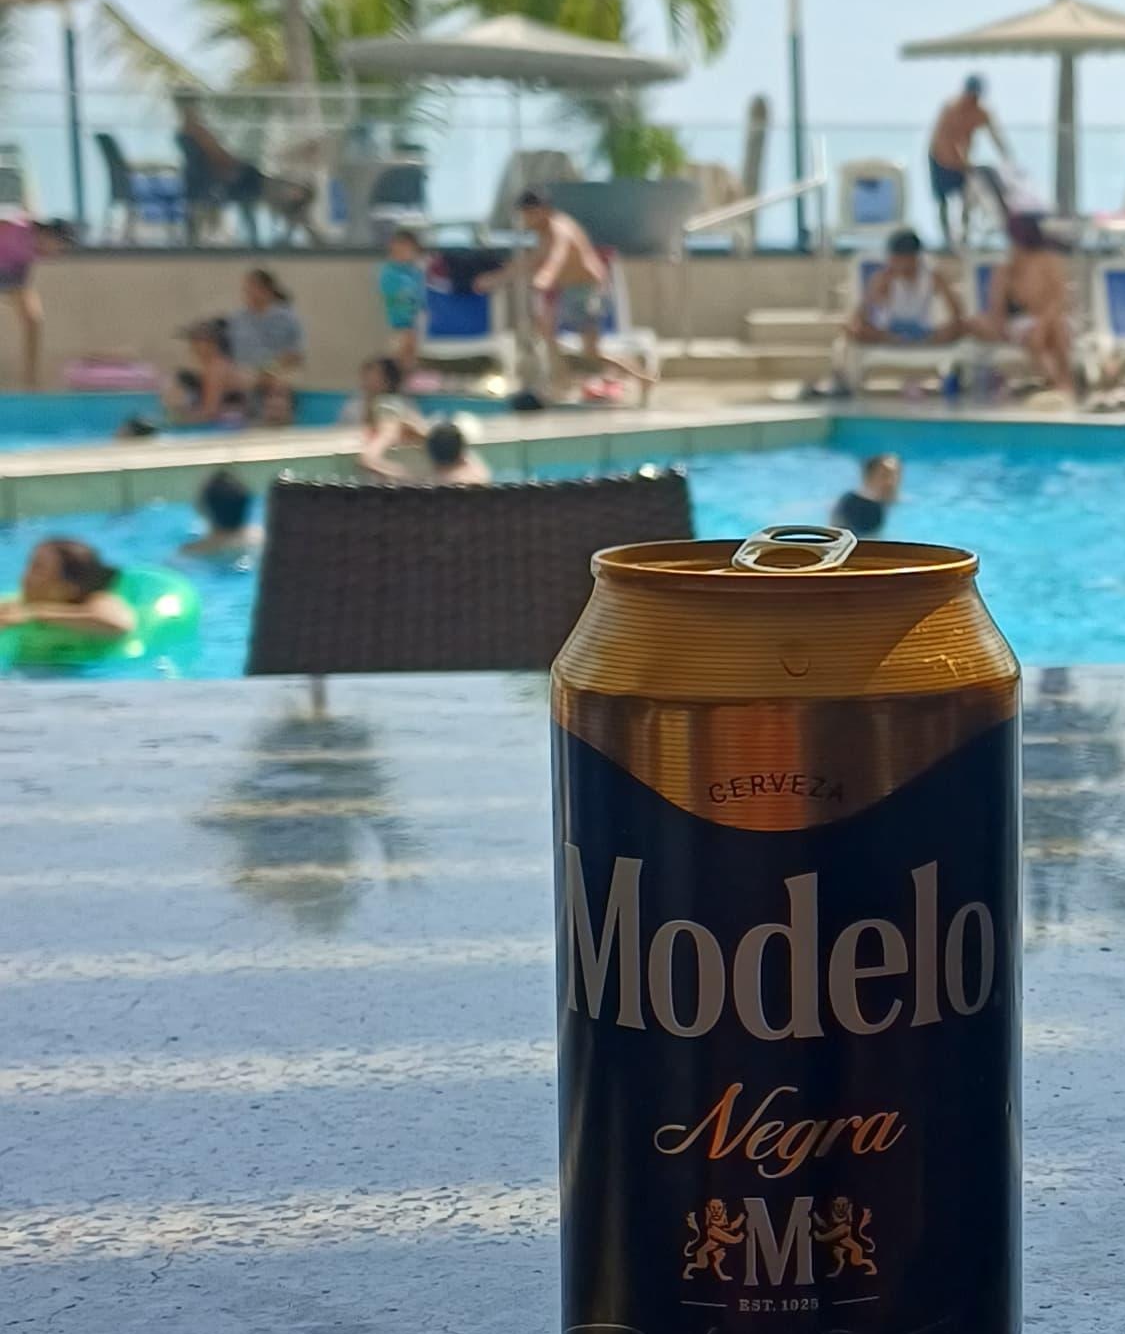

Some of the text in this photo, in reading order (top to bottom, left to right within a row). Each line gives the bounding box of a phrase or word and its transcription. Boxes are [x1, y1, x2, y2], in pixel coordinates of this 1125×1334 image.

[708, 772, 845, 804] CERVEZA
[564, 842, 996, 1041] Modelo
[653, 1082, 906, 1179] Negra
[743, 1196, 814, 1286] M
[738, 1298, 777, 1313] EST.
